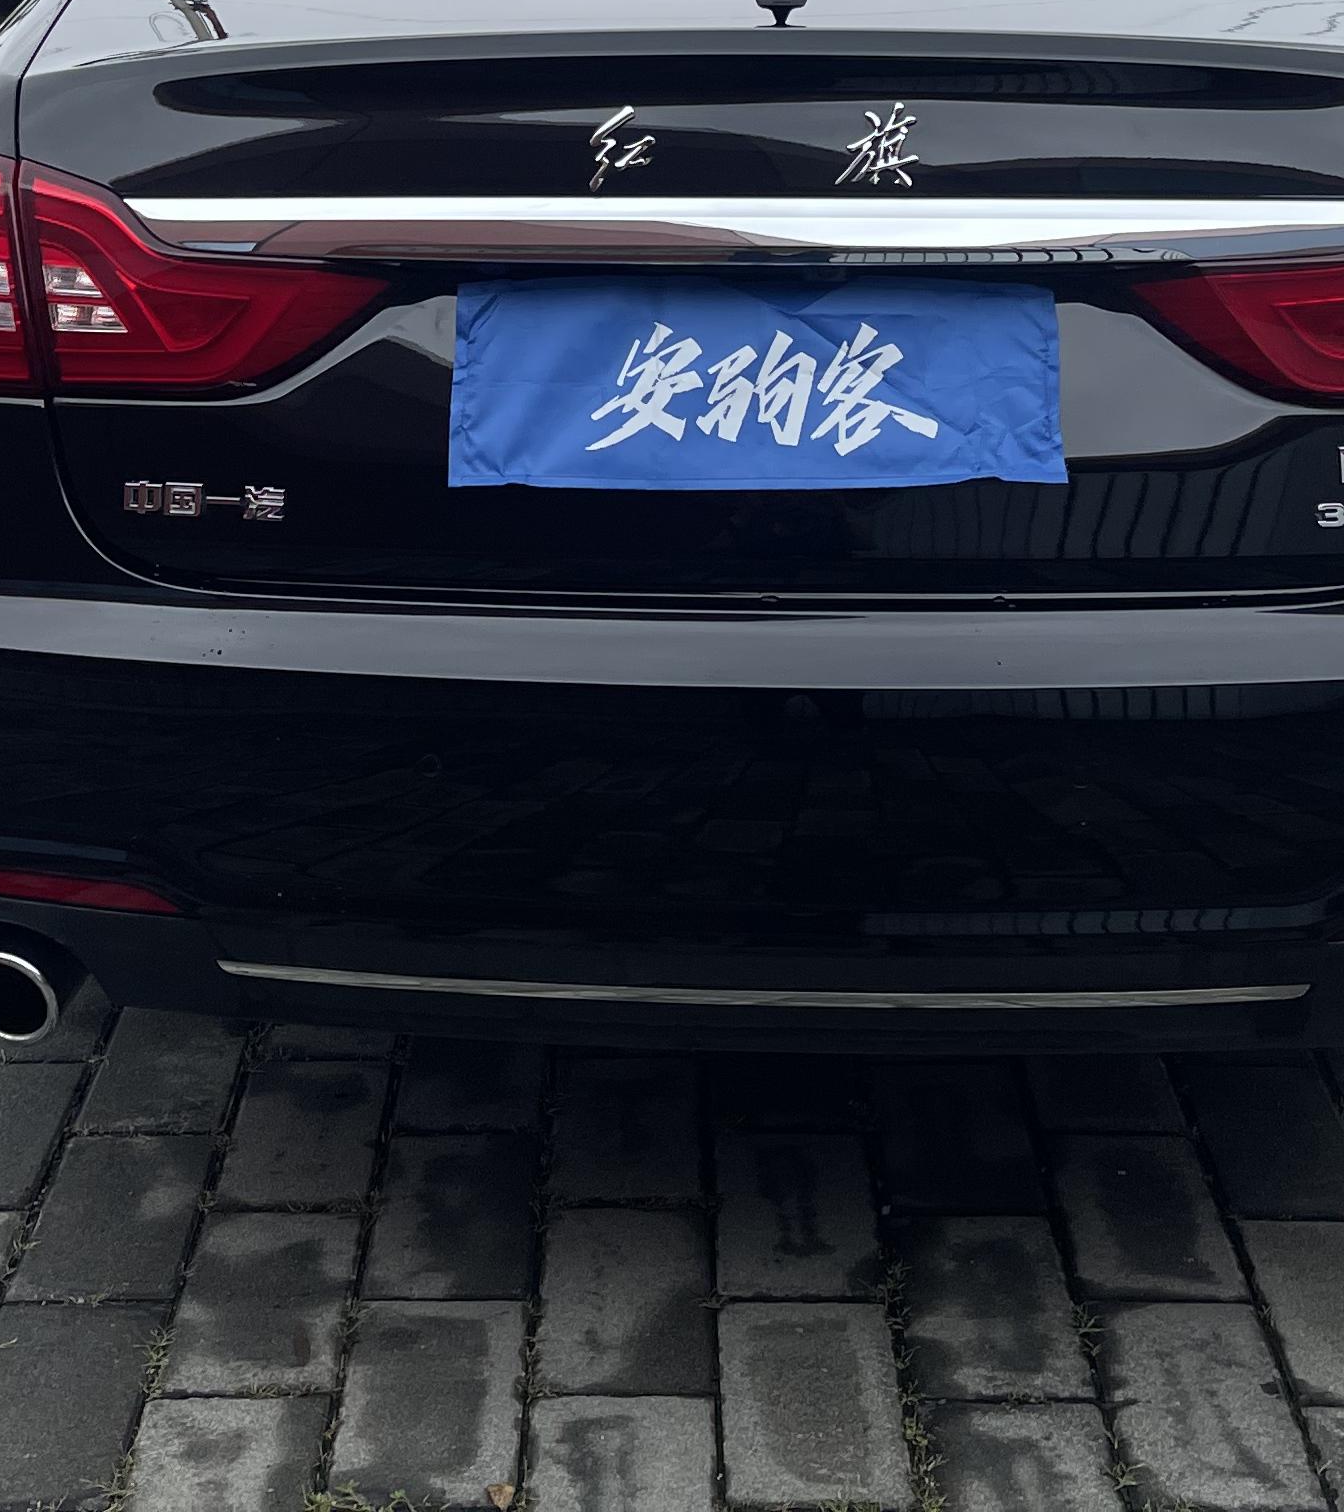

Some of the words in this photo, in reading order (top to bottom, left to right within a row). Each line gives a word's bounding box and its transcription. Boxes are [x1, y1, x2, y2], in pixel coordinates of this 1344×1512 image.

[589, 102, 920, 192] 红旗
[123, 480, 286, 522] 中国一汽
